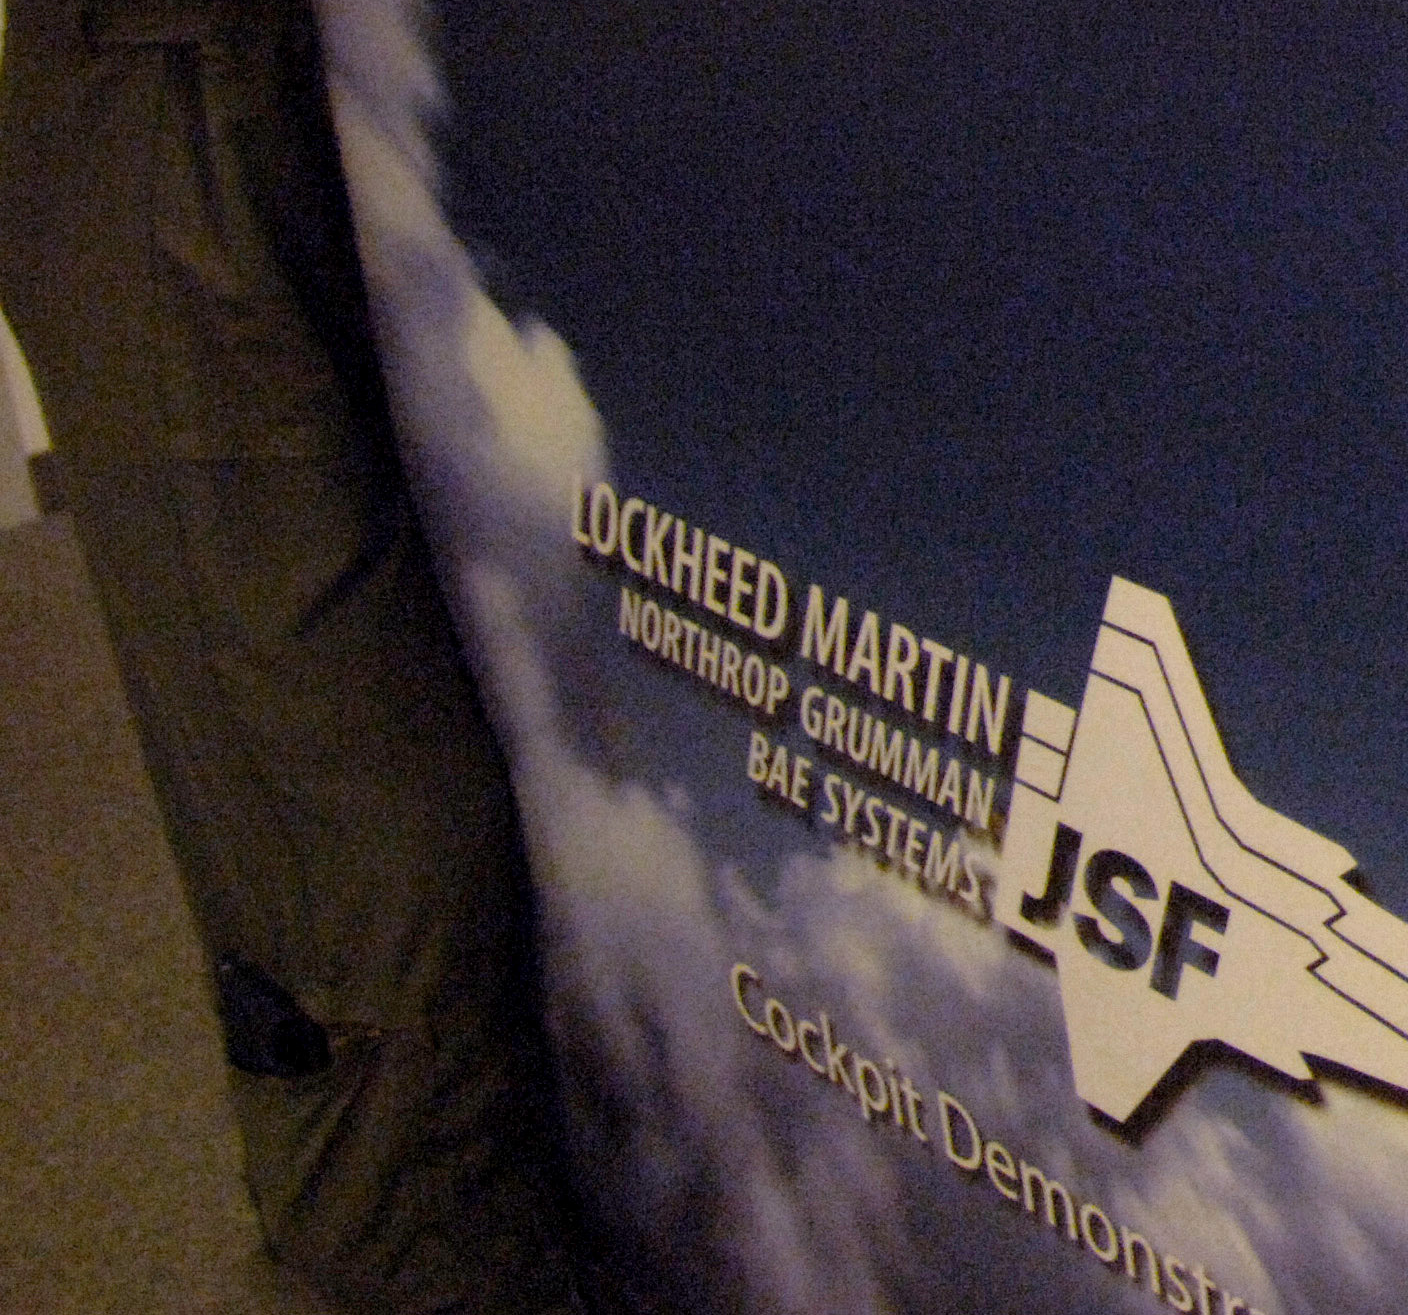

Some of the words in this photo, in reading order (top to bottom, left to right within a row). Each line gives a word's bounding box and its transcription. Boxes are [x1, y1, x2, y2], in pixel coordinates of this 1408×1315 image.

[570, 477, 788, 641] LOCKHEED
[800, 584, 1012, 755] MARTIN
[618, 587, 790, 715] NORTHROP
[800, 686, 999, 831] GRUMMAN
[746, 730, 811, 809] BAE
[820, 772, 987, 905] SYSTEMS
[1019, 822, 1231, 1001] JSF
[729, 962, 930, 1143] Cockpit
